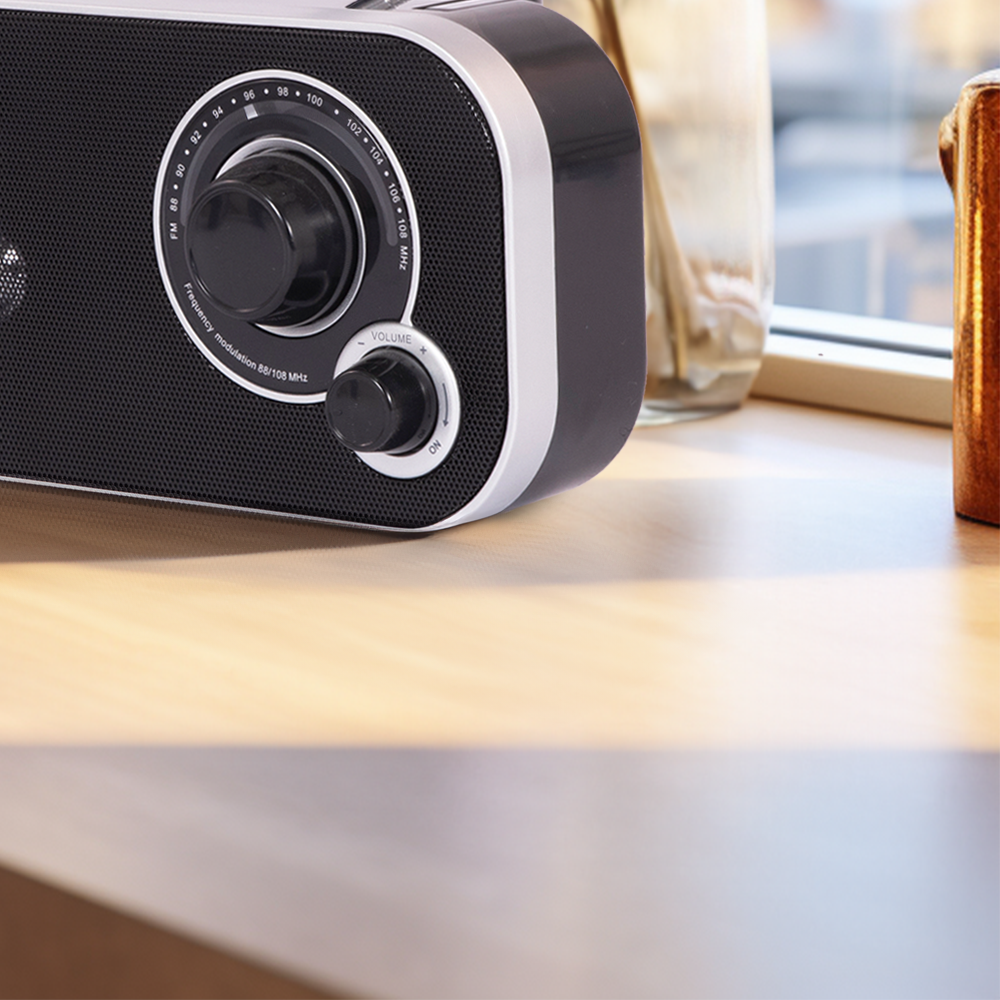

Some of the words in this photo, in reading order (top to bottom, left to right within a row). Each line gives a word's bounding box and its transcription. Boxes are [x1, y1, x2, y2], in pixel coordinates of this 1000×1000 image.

[243, 89, 256, 101] 96
[277, 87, 289, 97] 98
[306, 92, 323, 107] 100
[212, 105, 224, 119] 94
[346, 118, 363, 137] 102
[190, 130, 202, 145] 92
[370, 146, 384, 166] 104
[175, 163, 186, 178] 90
[387, 183, 400, 204] 106
[169, 197, 179, 212] 88
[170, 222, 179, 240] FM
[398, 218, 408, 239] 108
[398, 245, 408, 271] MHz
[184, 282, 214, 333] Frequency
[214, 333, 257, 370] modulation
[257, 364, 287, 381] 88/108
[288, 371, 308, 383] MHz
[371, 331, 412, 344] VOLUME
[429, 439, 442, 455] ON
